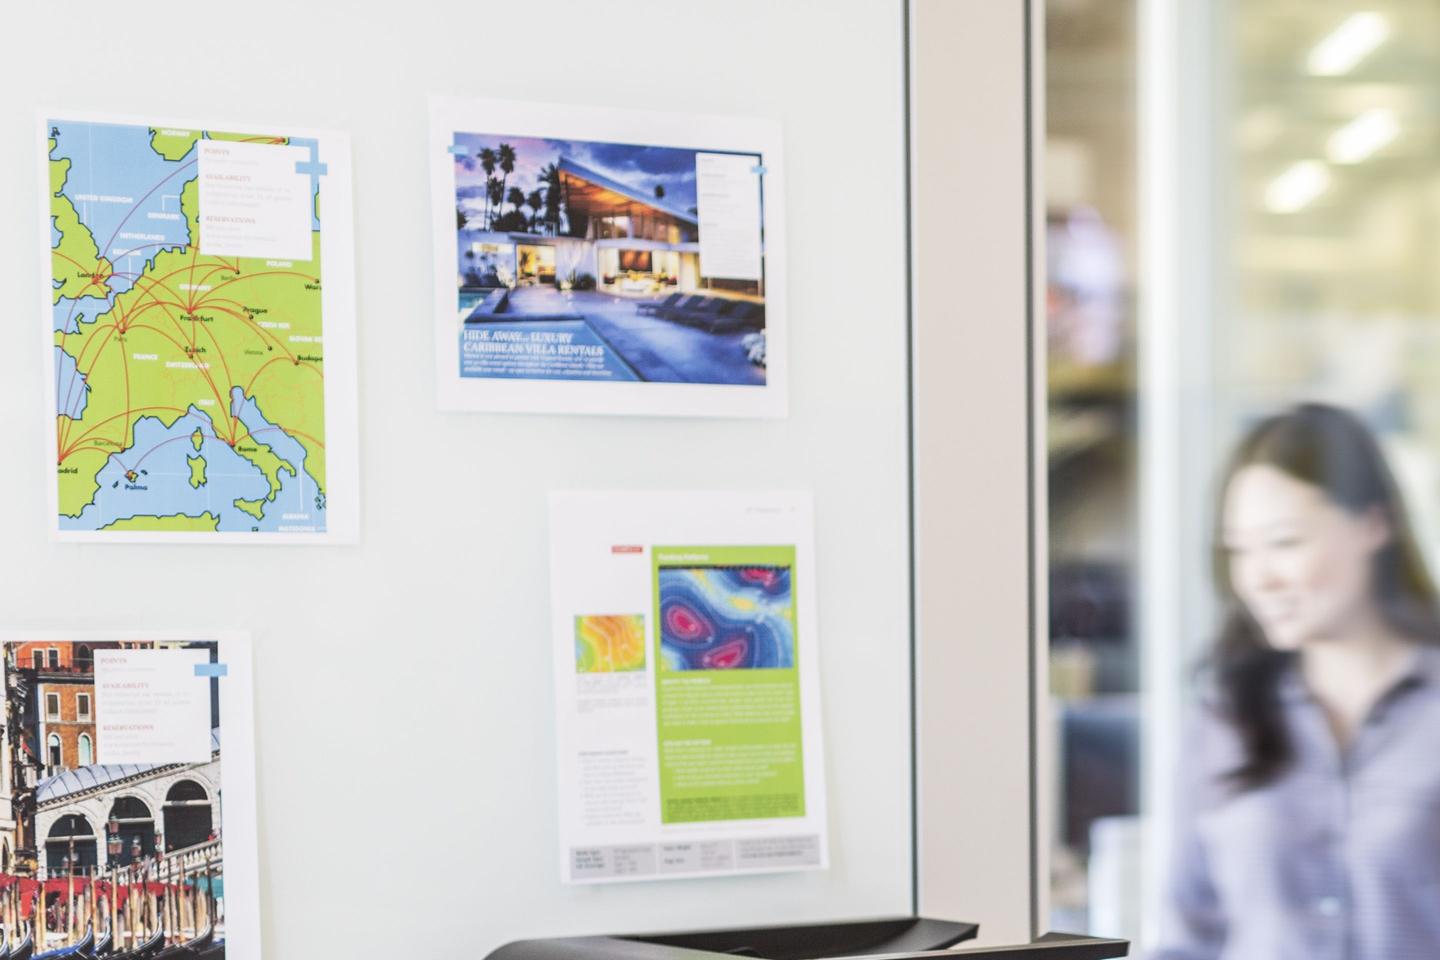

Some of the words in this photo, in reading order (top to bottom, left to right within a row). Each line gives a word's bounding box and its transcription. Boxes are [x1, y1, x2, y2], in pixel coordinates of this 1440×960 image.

[242, 305, 268, 317] Prague
[463, 329, 490, 342] HIDE
[530, 332, 574, 344] LUXURY
[463, 341, 525, 354] CARIBBEAN
[526, 343, 556, 355] VILLA
[557, 344, 604, 356] RENTALS
[124, 482, 149, 492] Palma
